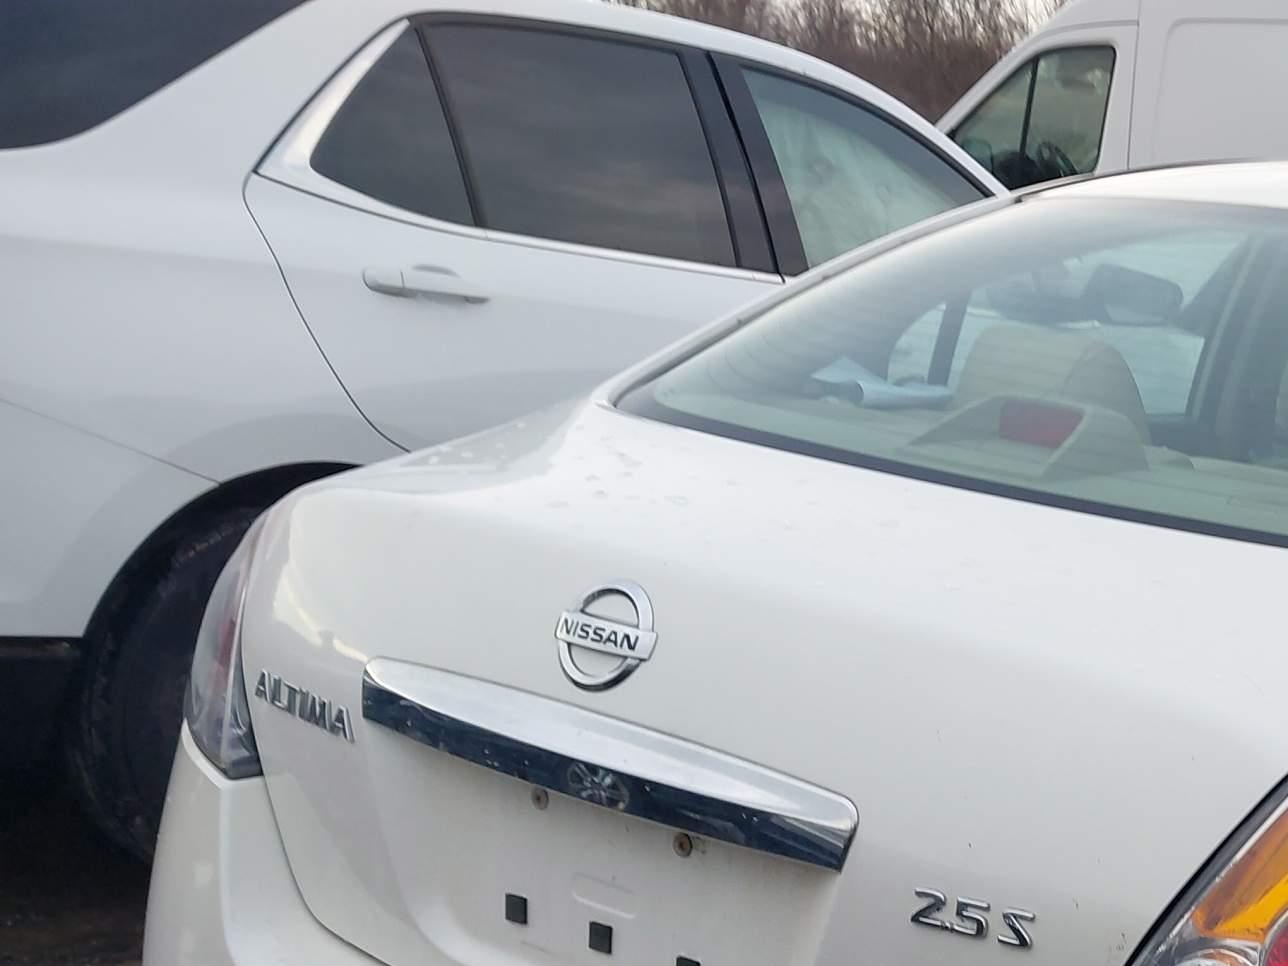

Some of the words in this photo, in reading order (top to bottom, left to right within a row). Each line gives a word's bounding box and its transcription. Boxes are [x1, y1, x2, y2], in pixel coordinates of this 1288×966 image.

[560, 617, 640, 652] NISSAN
[254, 668, 355, 744] ALTIMA
[996, 907, 1036, 949] S
